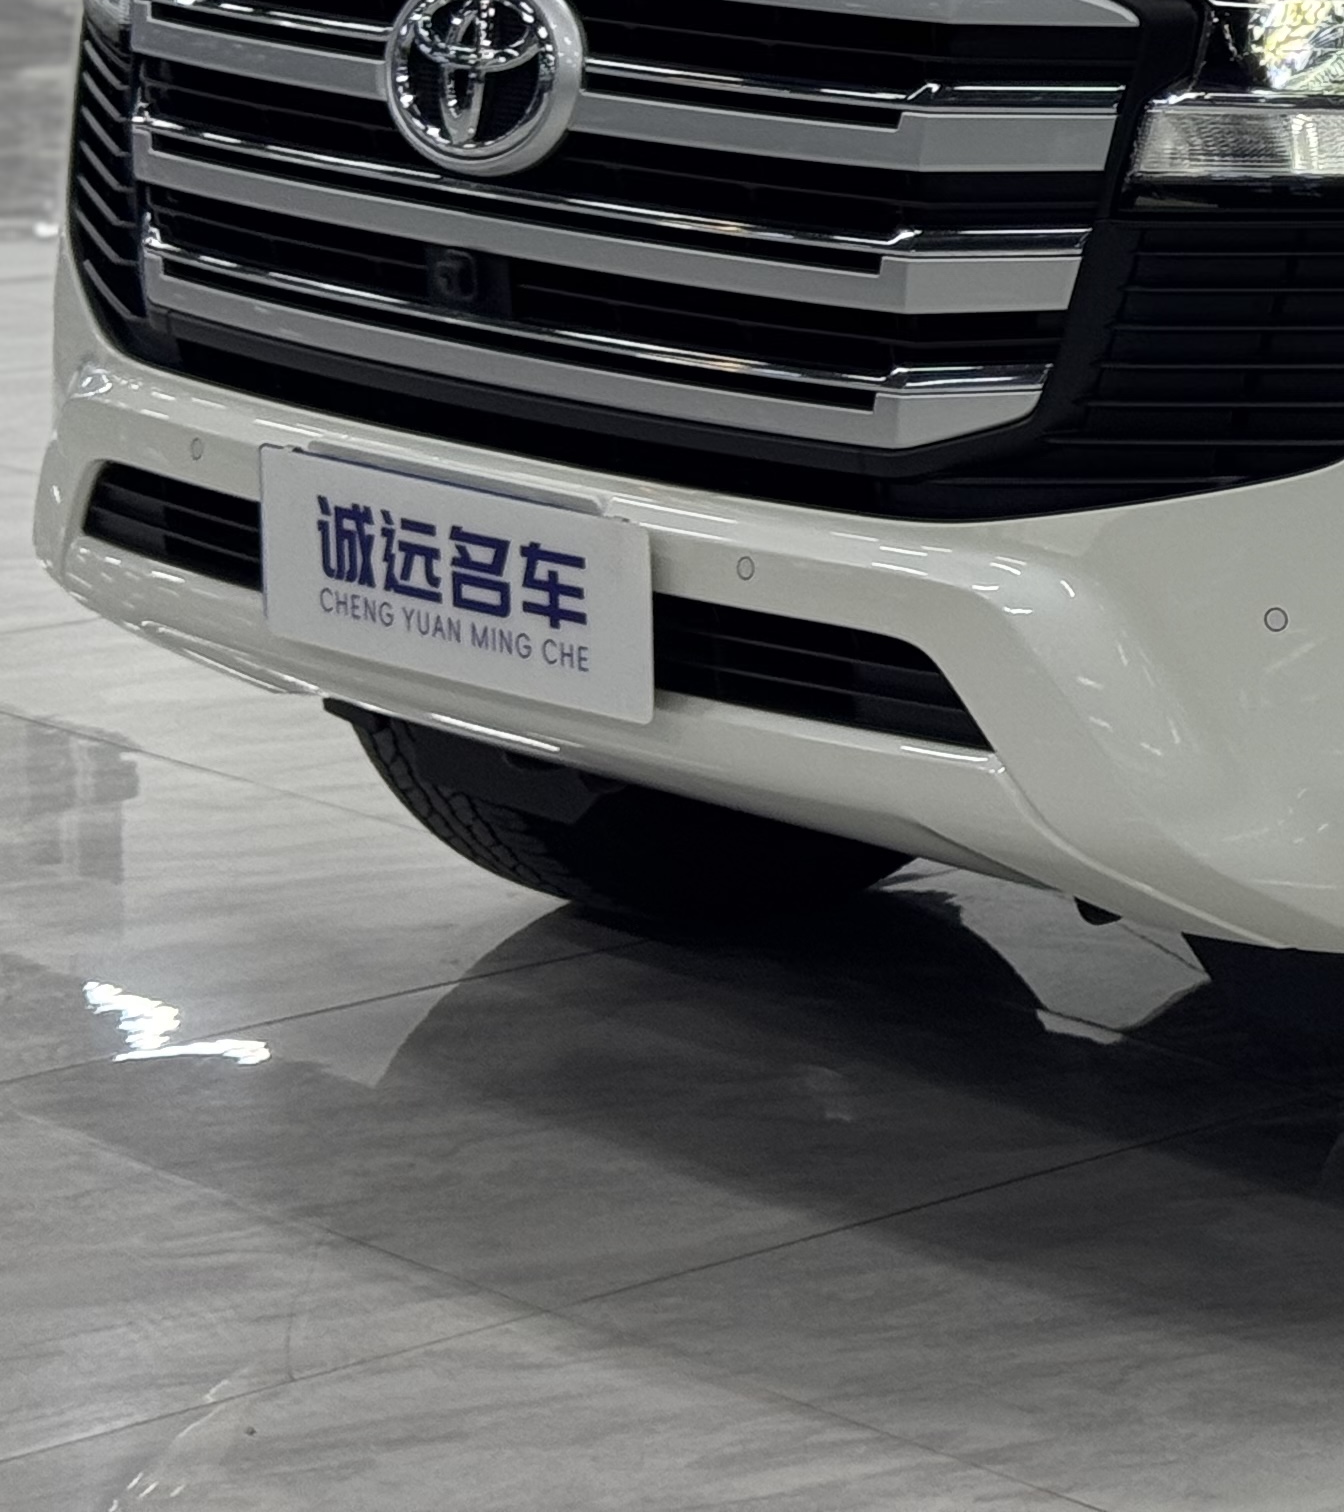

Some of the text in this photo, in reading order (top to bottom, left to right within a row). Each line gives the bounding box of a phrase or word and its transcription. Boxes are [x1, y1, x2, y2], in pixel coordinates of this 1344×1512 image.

[317, 495, 587, 629] 诚远名车
[320, 588, 590, 672] CHENG YUAN MING CHE
